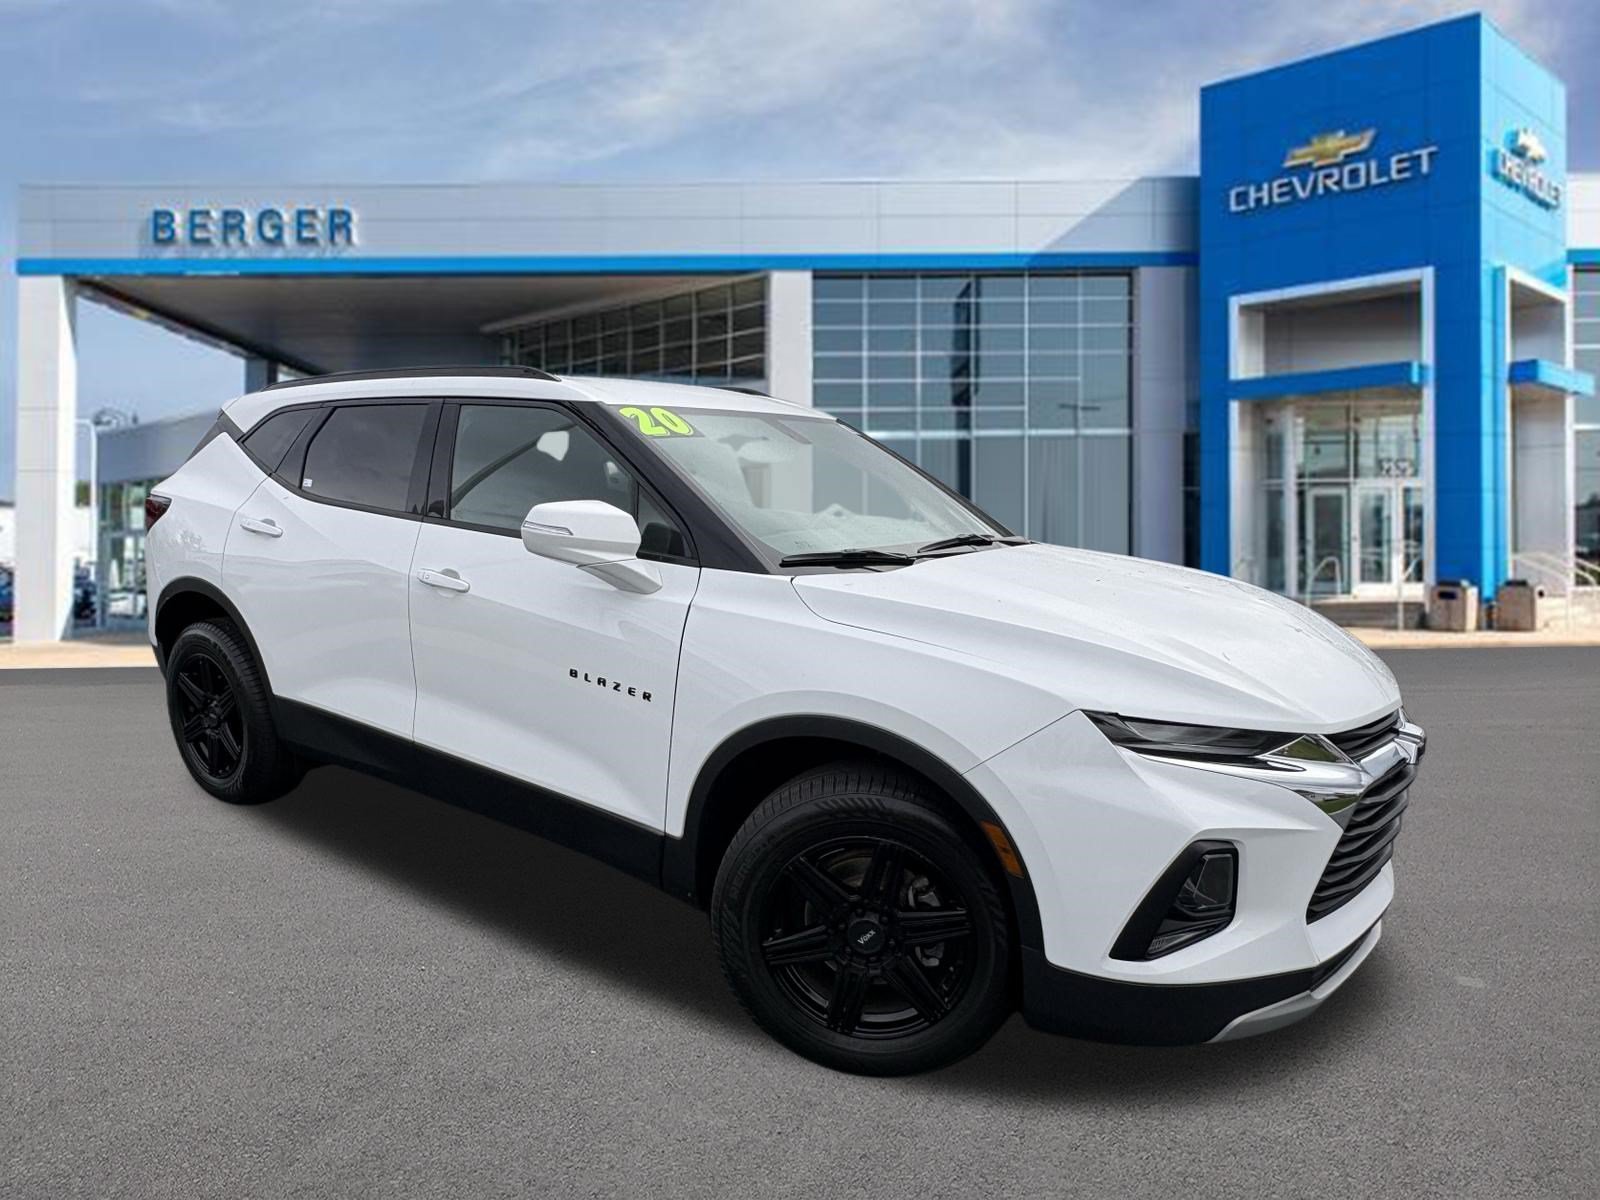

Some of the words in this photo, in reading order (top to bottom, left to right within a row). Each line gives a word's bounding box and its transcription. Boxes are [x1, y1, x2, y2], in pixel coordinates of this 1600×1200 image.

[1230, 146, 1438, 213] CHEVROLET
[152, 208, 357, 246] BERGER
[618, 407, 693, 436] 20
[569, 668, 652, 702] BLAZER
